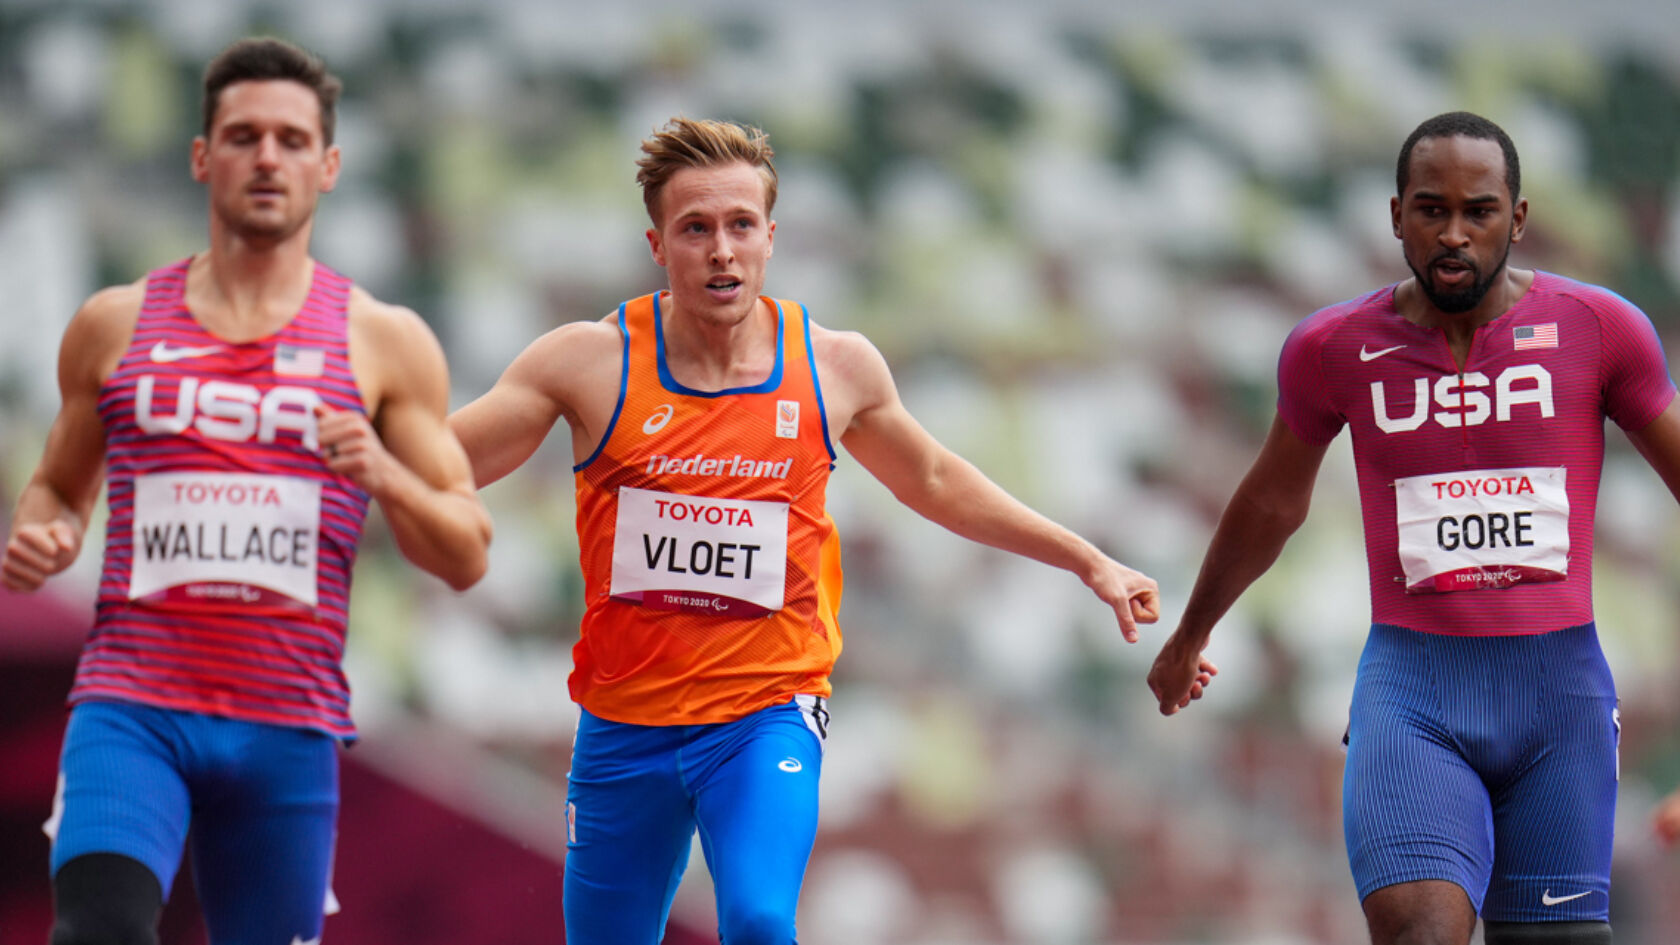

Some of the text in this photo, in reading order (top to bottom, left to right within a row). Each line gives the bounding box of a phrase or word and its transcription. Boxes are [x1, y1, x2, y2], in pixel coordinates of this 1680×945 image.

[1371, 364, 1555, 434] USA
[135, 375, 322, 451] USA
[645, 454, 793, 480] nederland
[171, 482, 281, 506] TOYOTA
[1432, 476, 1535, 500] TOYOTA
[655, 500, 754, 527] TOYOTA
[1437, 511, 1535, 551] GORE
[143, 523, 310, 567] WALLACE
[643, 534, 760, 579] VLOET
[1456, 573, 1482, 582] TOKYO
[663, 595, 710, 607] TOKYO 2020
